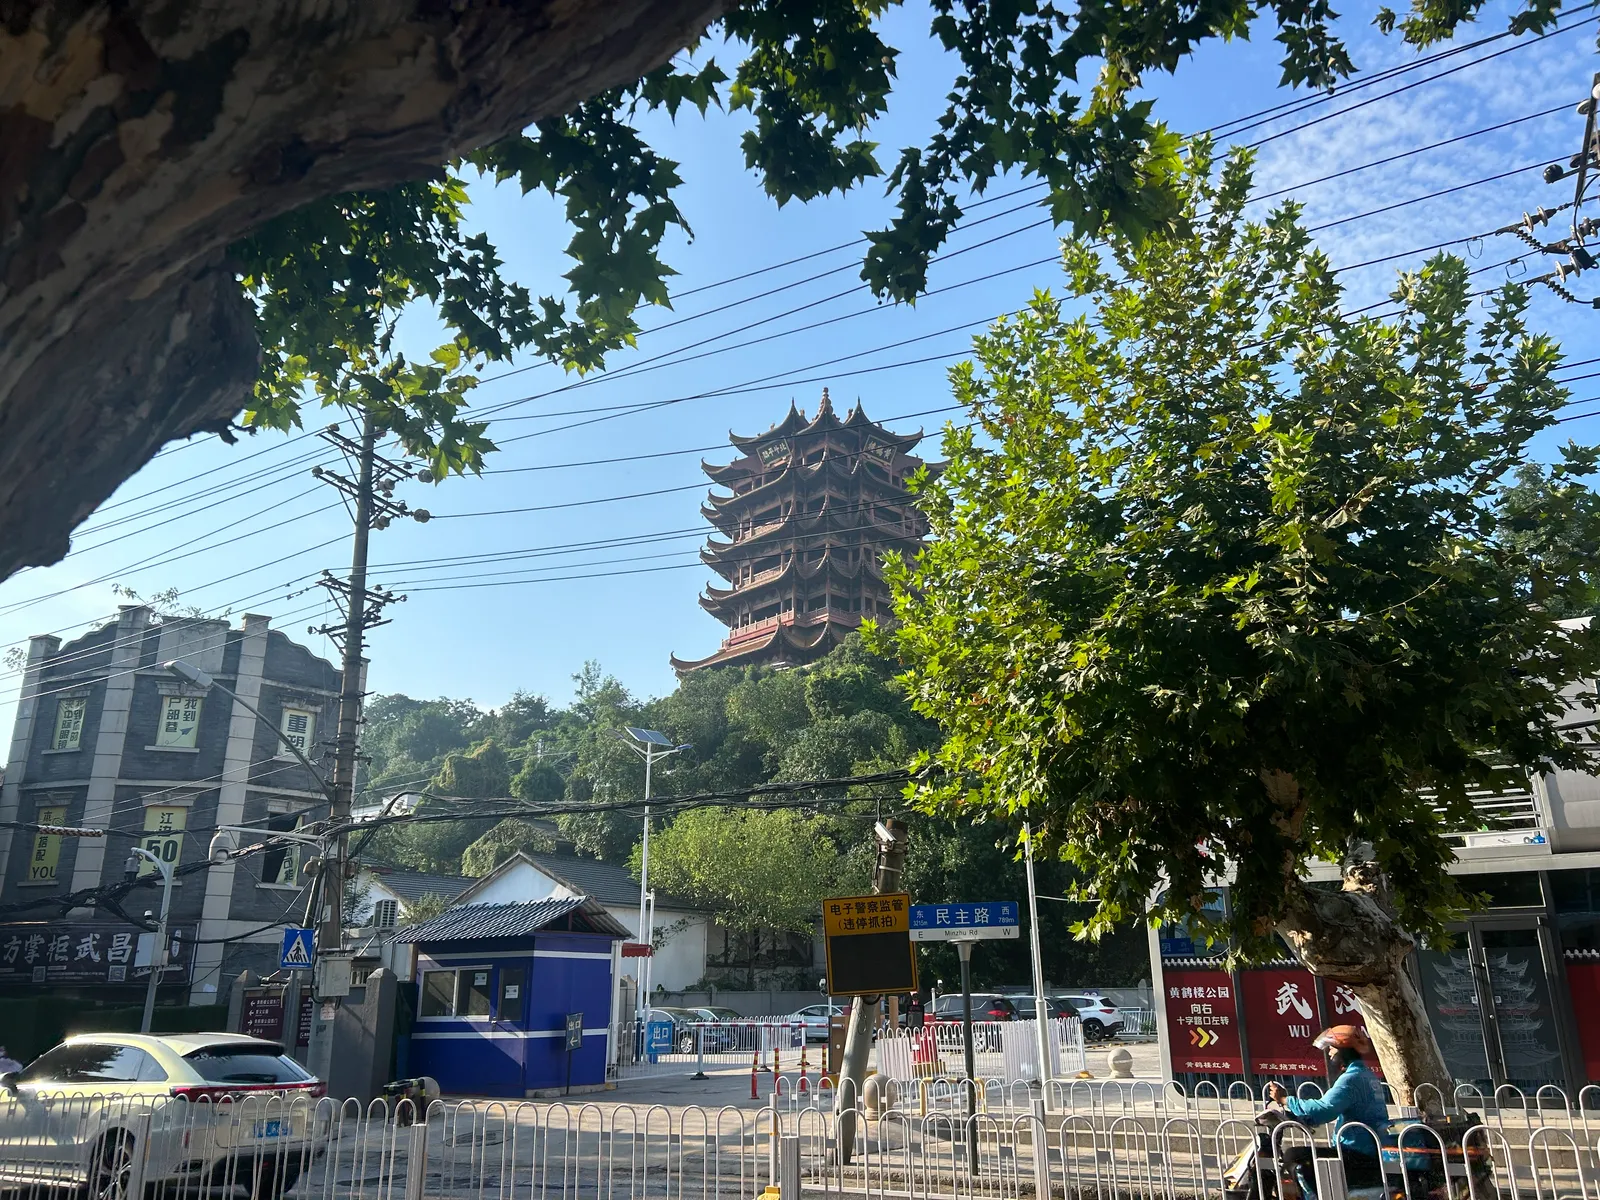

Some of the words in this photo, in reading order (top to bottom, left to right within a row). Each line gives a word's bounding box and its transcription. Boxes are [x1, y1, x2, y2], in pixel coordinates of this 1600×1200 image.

[183, 699, 198, 721] 找到
[145, 839, 178, 862] 50
[830, 899, 903, 916] 电子警察监管
[916, 910, 924, 919] 东
[936, 907, 990, 925] 民主路
[1001, 906, 1010, 915] 西
[1002, 928, 1011, 936] W
[1169, 986, 1230, 999] 黄鹤楼公园
[1275, 981, 1313, 1020] 武
[1190, 1003, 1212, 1015] 向右
[569, 1020, 581, 1031] 出口
[1176, 1016, 1230, 1026] 十字路口左转
[653, 1026, 669, 1040] 出口
[1288, 1025, 1311, 1038] WU
